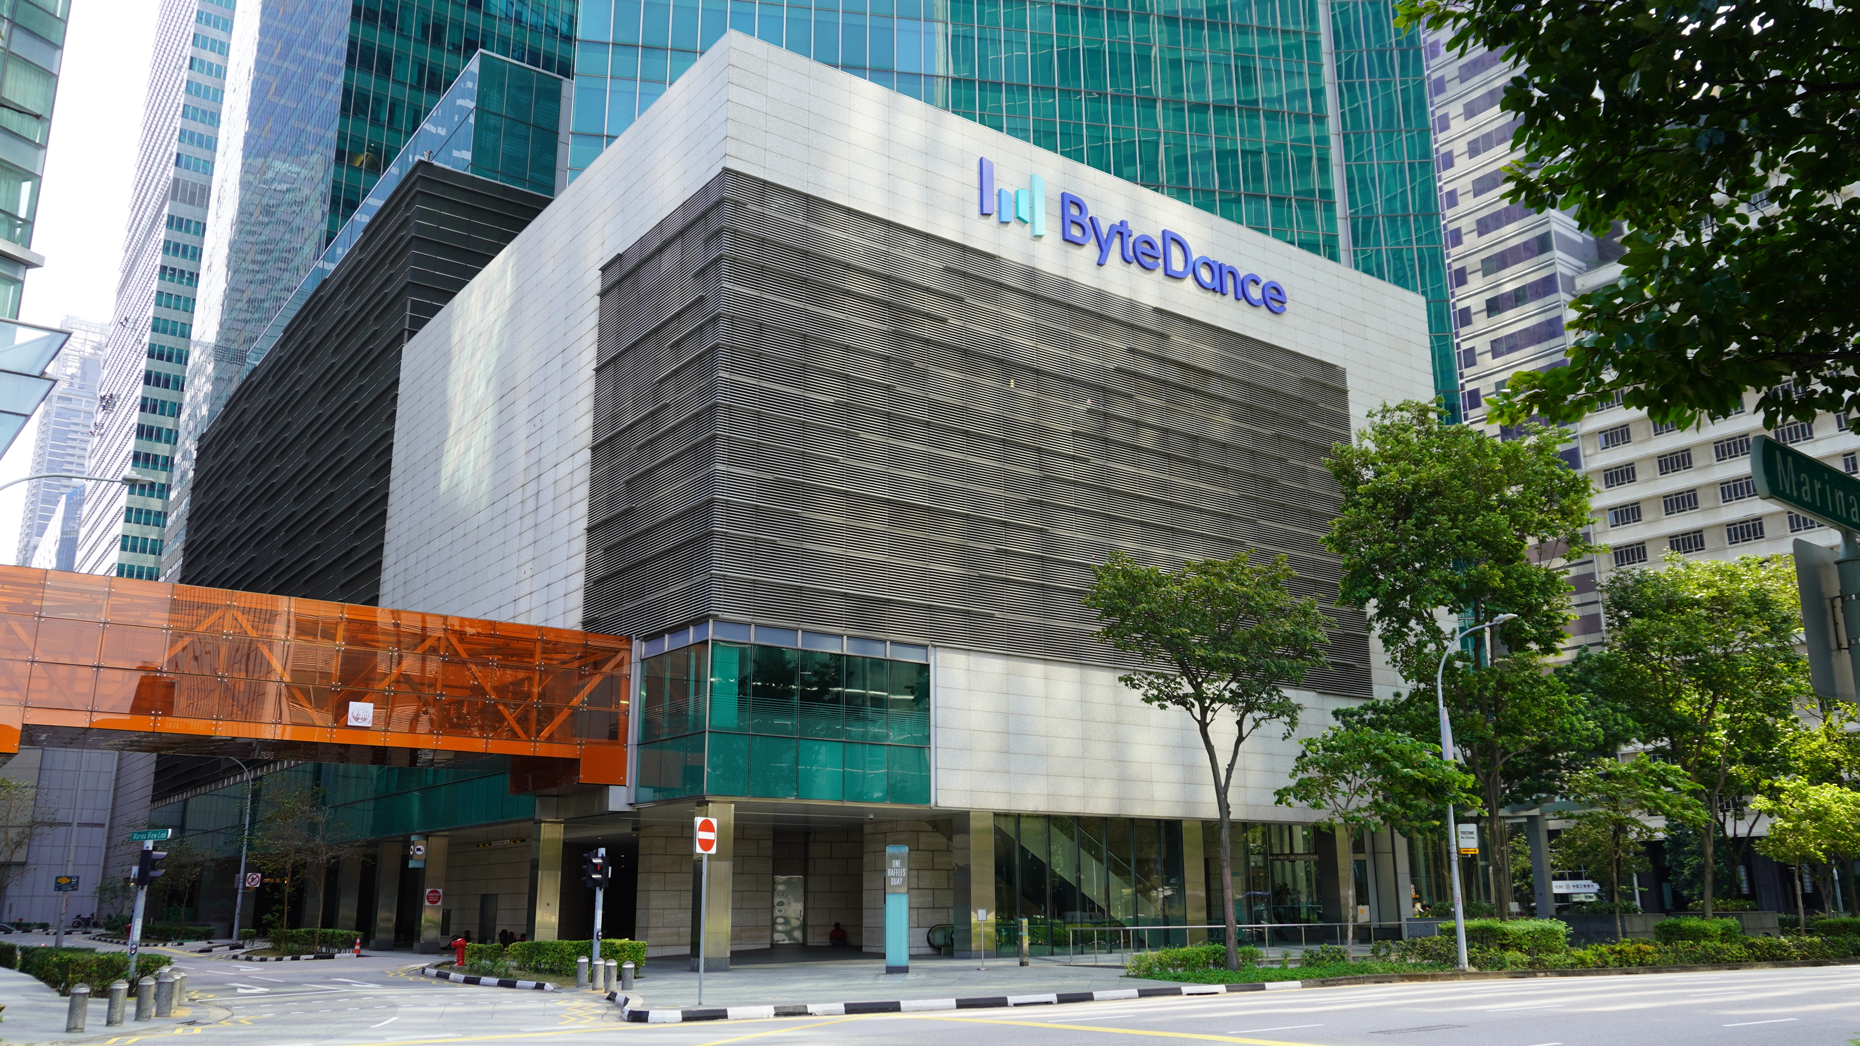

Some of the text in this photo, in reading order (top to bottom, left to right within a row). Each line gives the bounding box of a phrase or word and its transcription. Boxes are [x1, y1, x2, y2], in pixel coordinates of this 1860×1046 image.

[1061, 192, 1287, 314] ByteDance
[1775, 449, 1860, 524] Marina
[892, 860, 901, 868] ONE
